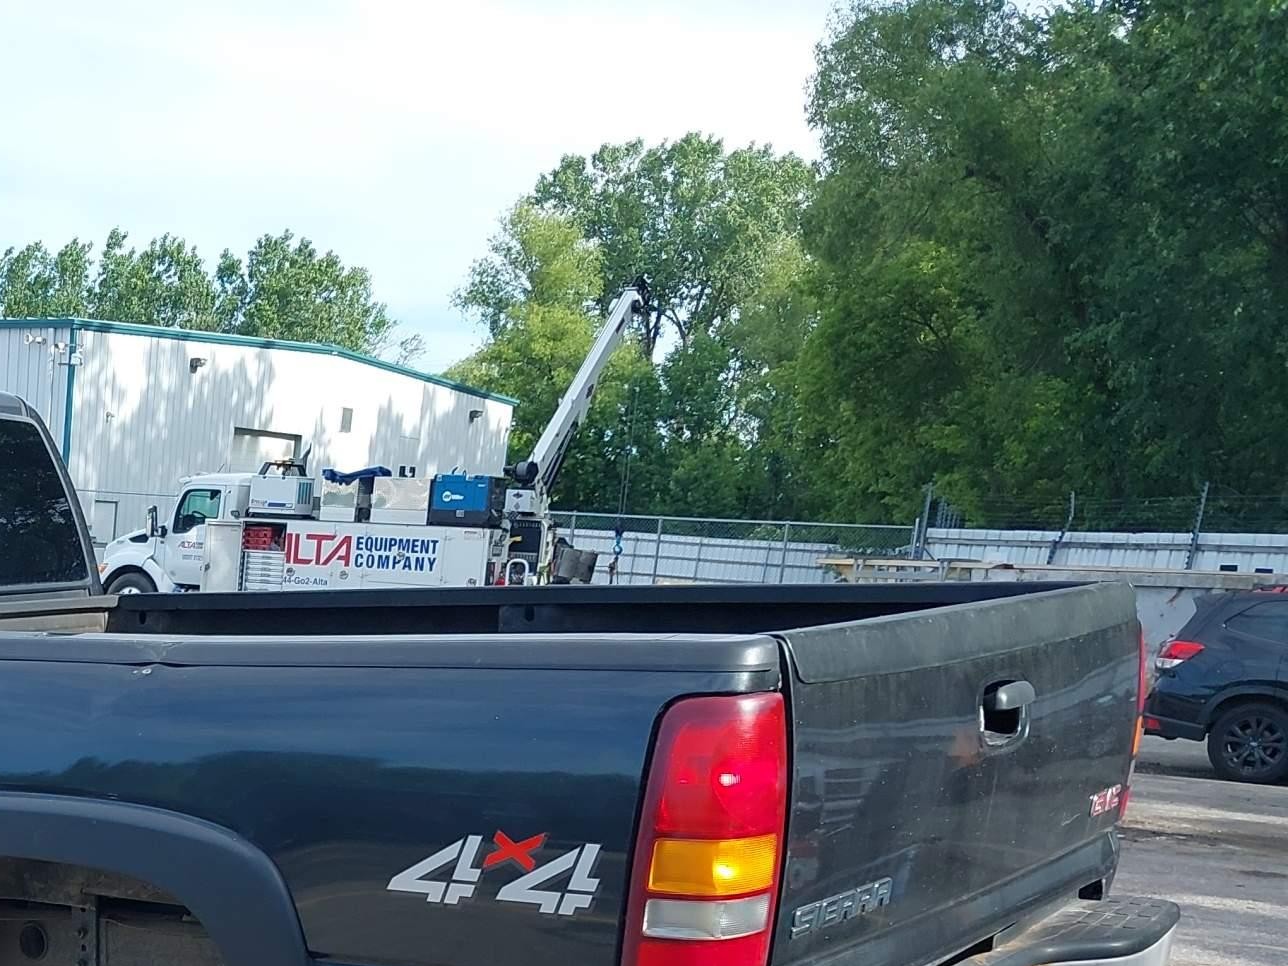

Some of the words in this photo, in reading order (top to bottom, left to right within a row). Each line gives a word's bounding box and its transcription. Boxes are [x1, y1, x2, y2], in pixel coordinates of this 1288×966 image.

[355, 535, 440, 555] EQUIPMENT
[353, 552, 438, 572] COMPANY
[790, 876, 893, 939] SIERRA
